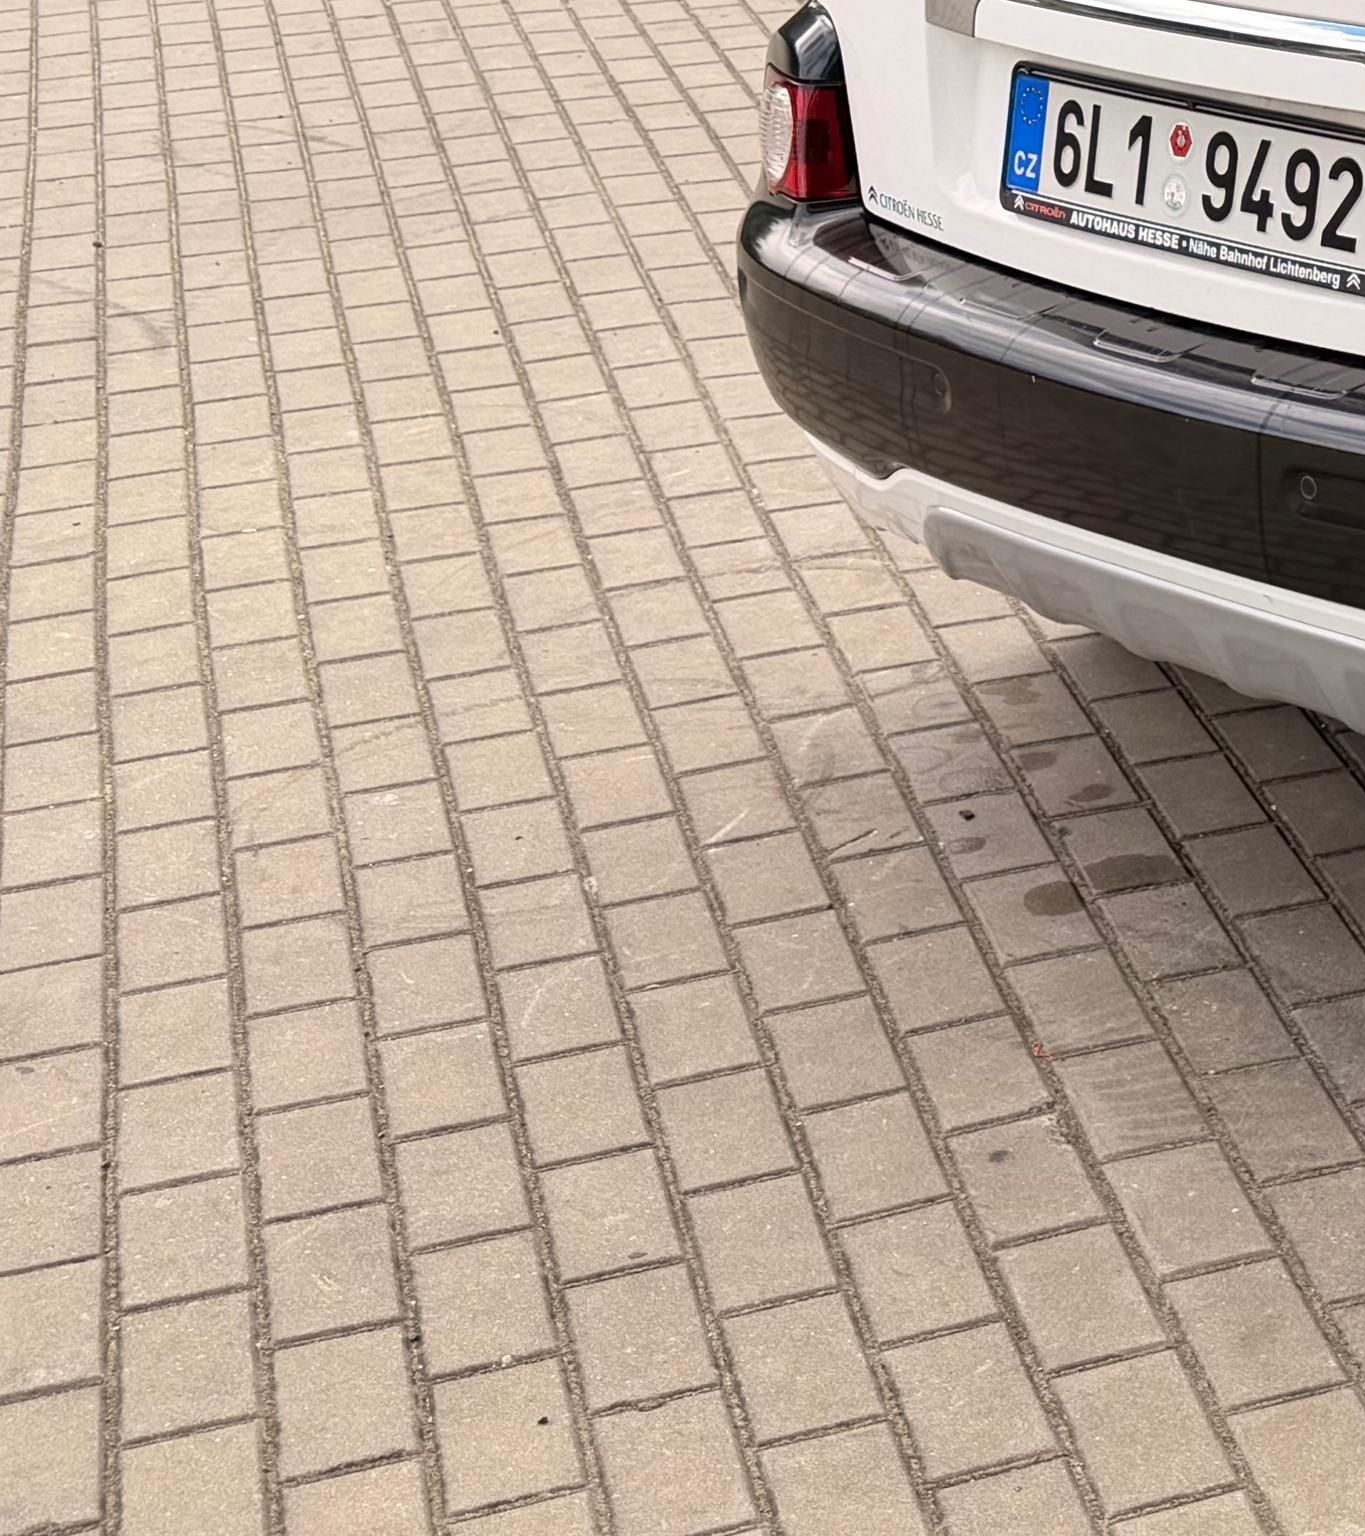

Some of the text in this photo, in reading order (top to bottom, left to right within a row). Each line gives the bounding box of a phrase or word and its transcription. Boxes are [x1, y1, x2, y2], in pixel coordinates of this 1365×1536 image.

[1013, 150, 1038, 179] CZ
[1053, 99, 1364, 254] 6L1 9492
[916, 208, 944, 231] HESSE
[1069, 210, 1136, 239] AUTOHAUS
[1138, 226, 1180, 250] HESSE
[1188, 237, 1217, 258] Nähe
[1219, 245, 1268, 271] Bahnhof
[1269, 258, 1341, 290] Lichtenberg
